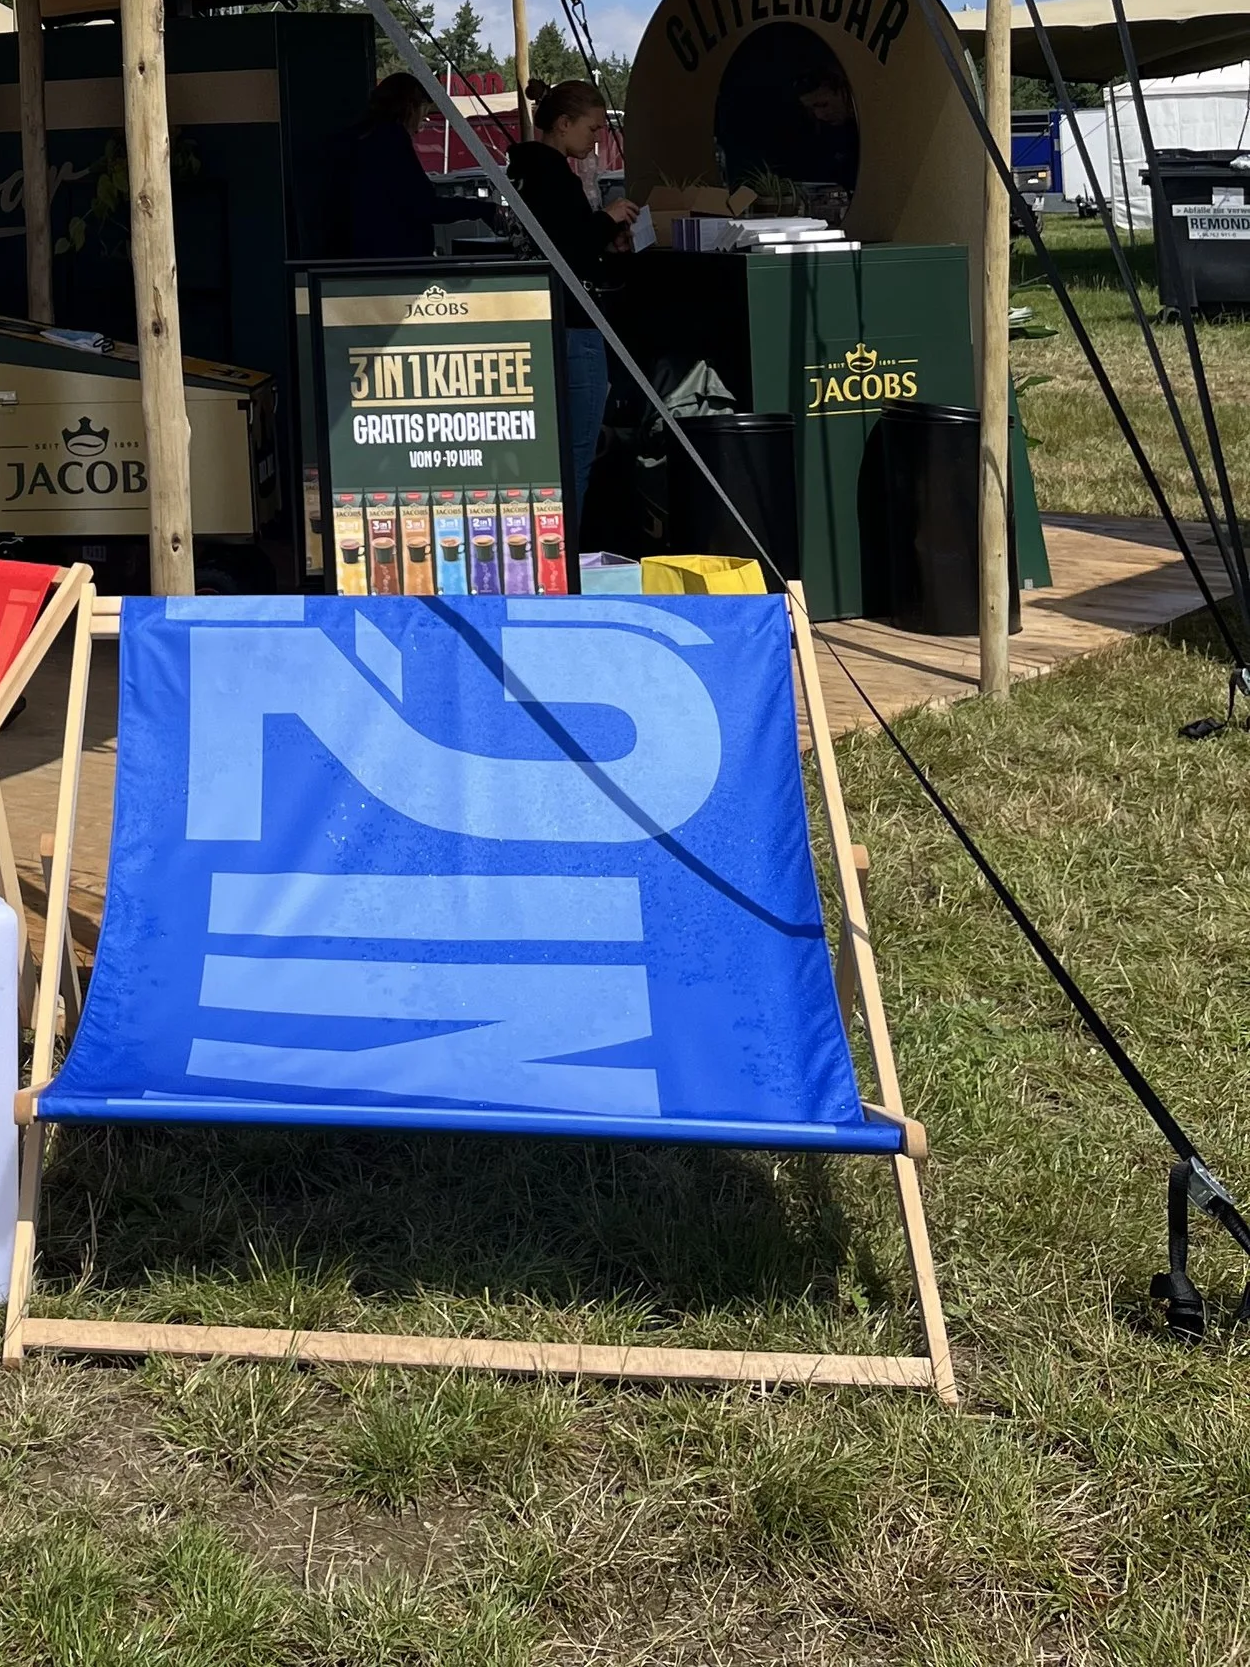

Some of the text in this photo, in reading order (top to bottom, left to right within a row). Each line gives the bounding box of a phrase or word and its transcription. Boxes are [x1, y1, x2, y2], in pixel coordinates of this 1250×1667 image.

[405, 302, 469, 318] JACOBS
[350, 351, 534, 399] 3 IN 1 KAFFEE
[808, 371, 918, 409] JACOBS
[353, 410, 536, 445] GRATIS PROBIEREN
[409, 450, 432, 468] VON
[459, 449, 483, 467] UHR
[5, 460, 148, 501] JACOB
